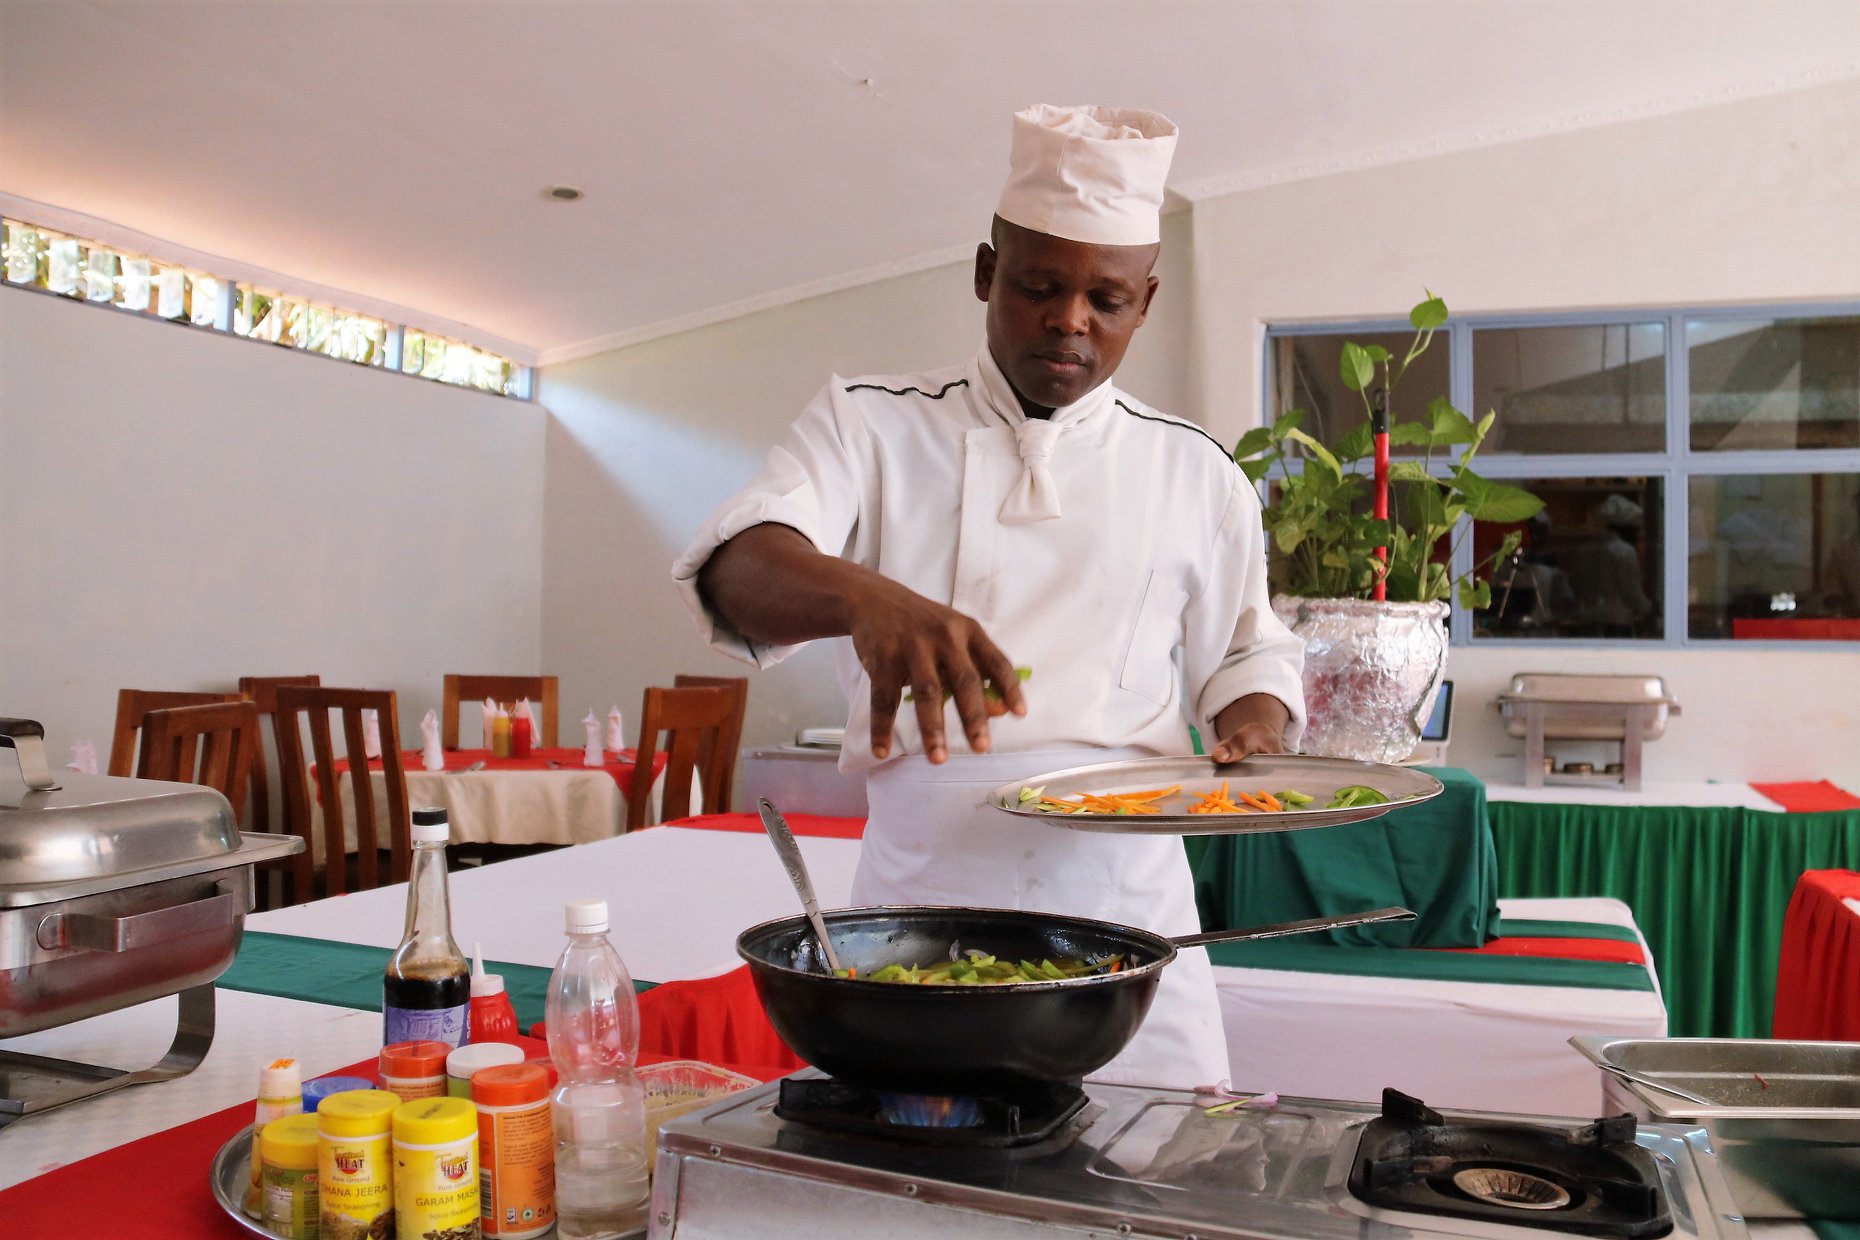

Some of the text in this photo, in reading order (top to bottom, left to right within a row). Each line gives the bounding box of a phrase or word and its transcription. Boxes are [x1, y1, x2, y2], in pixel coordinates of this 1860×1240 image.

[336, 1159, 365, 1168] HEAT
[443, 1161, 468, 1176] HEAT
[356, 1184, 388, 1197] JEERA
[416, 1196, 453, 1207] GARAM
